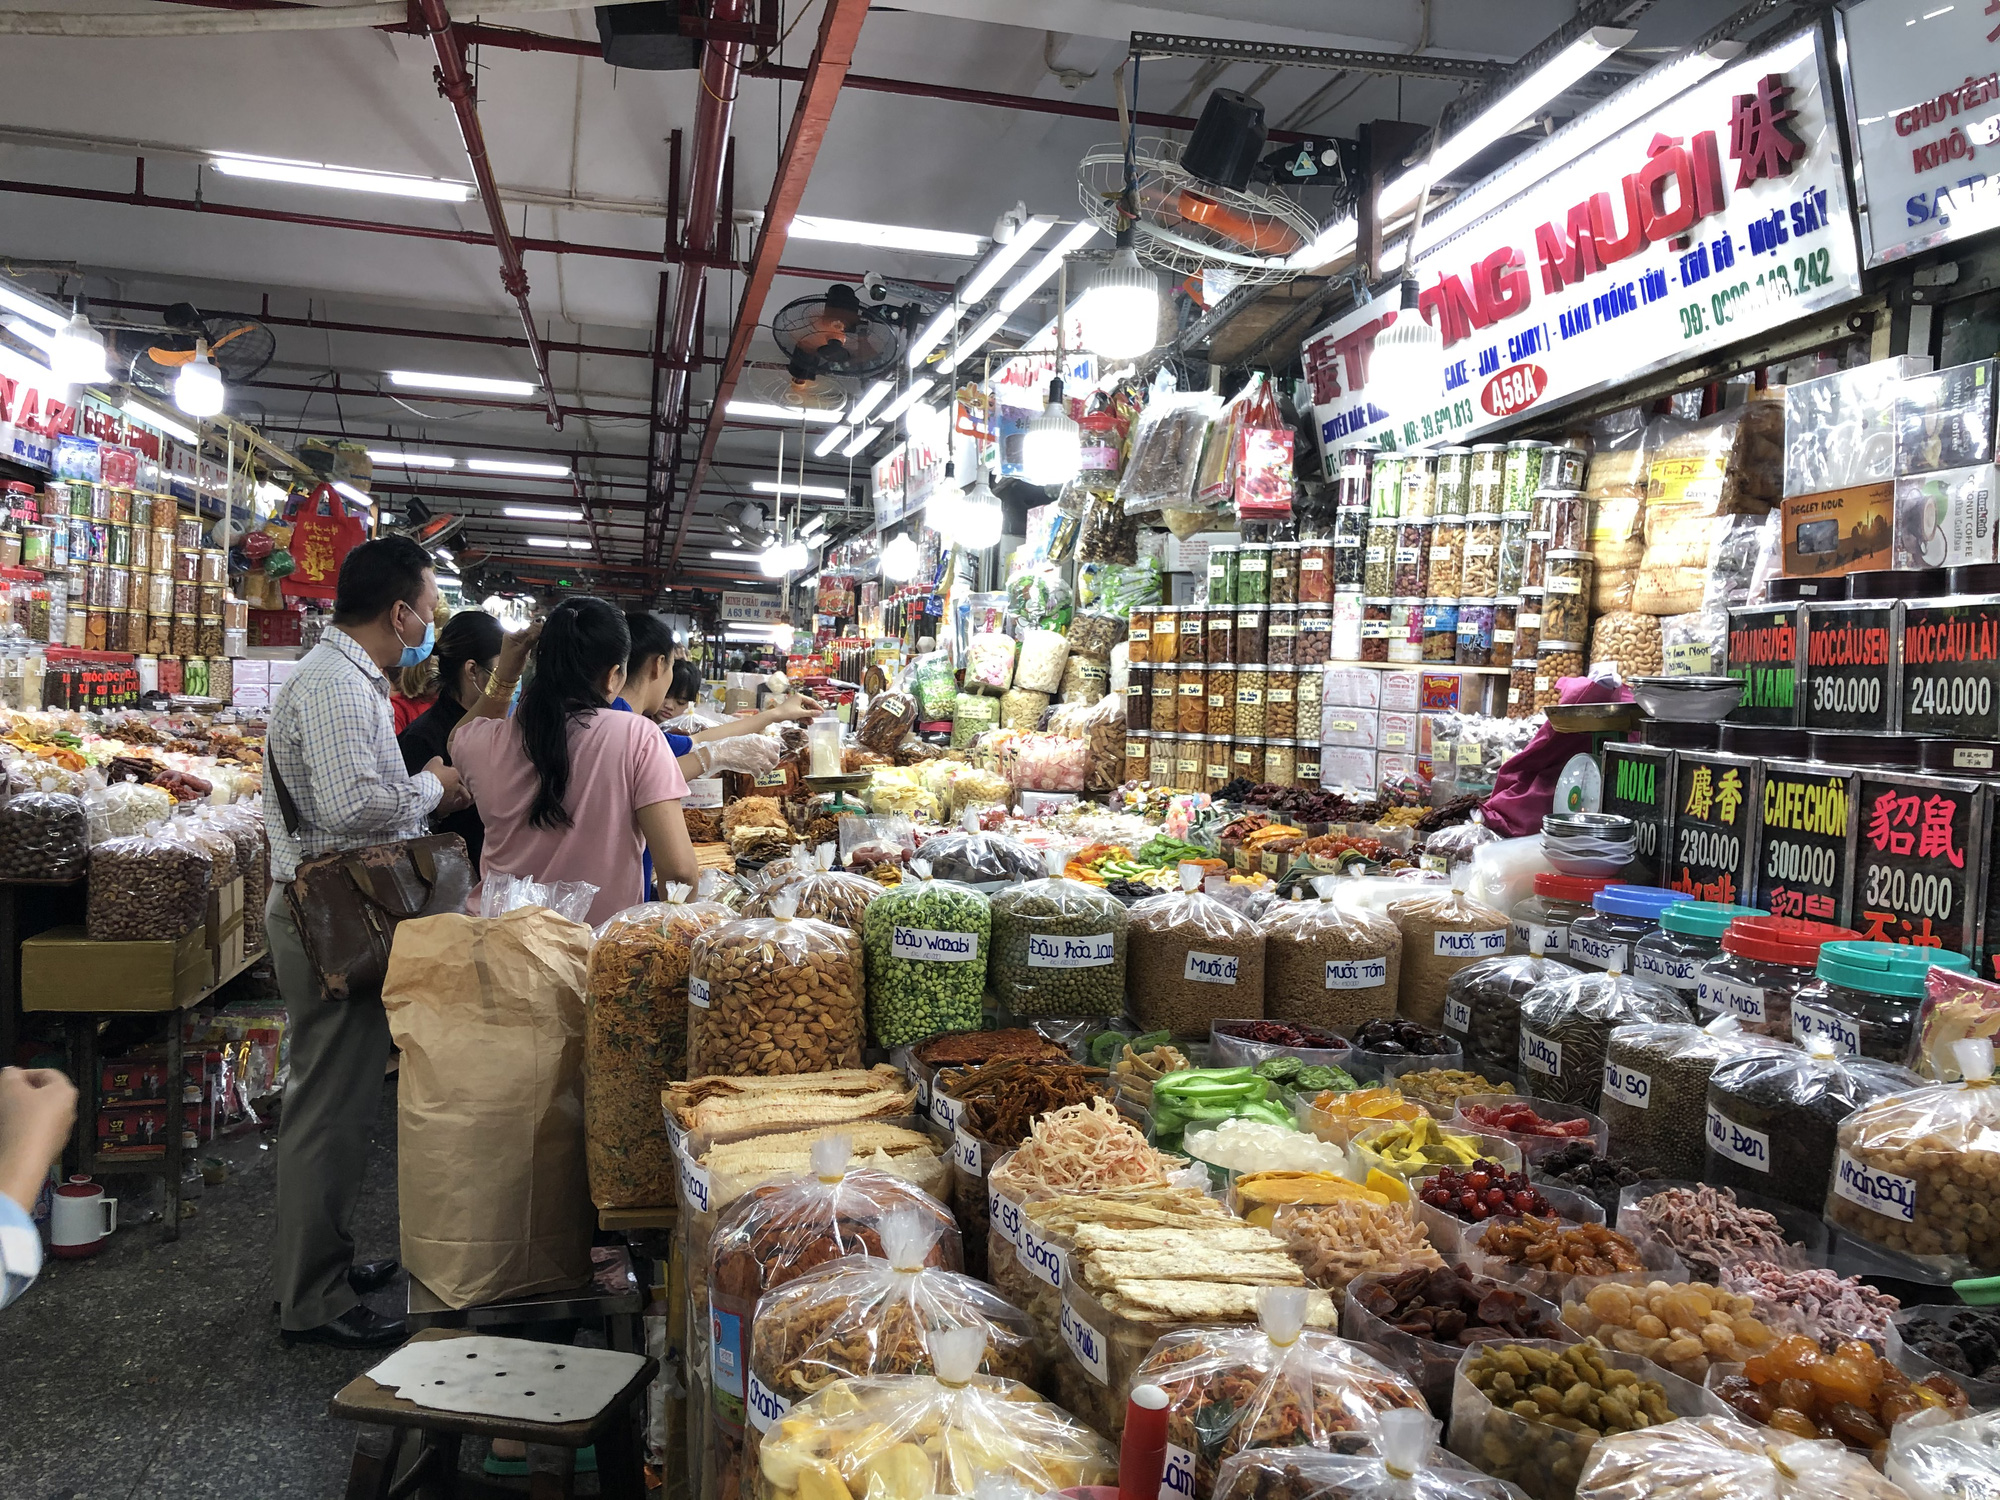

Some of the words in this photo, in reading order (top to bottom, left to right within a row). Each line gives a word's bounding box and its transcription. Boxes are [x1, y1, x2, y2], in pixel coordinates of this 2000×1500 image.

[1728, 72, 1801, 191] 妹
[1535, 130, 1726, 297] MUỘI
[1479, 346, 1501, 377] JAM
[1559, 304, 1592, 341] BÁNH
[1638, 266, 1669, 306] TÔM
[1678, 241, 1710, 288] KHÔ
[1790, 184, 1830, 239] SẤY
[1491, 365, 1539, 415] A58A
[725, 596, 741, 606] MINH
[1756, 667, 1796, 709] XANH
[1813, 675, 1881, 714] 360.000
[1911, 675, 1992, 716] 240.000
[1615, 759, 1657, 806] MOKA
[1679, 828, 1741, 873] 230.000
[1767, 839, 1836, 888] 300.000
[1865, 863, 1953, 921] 320.000
